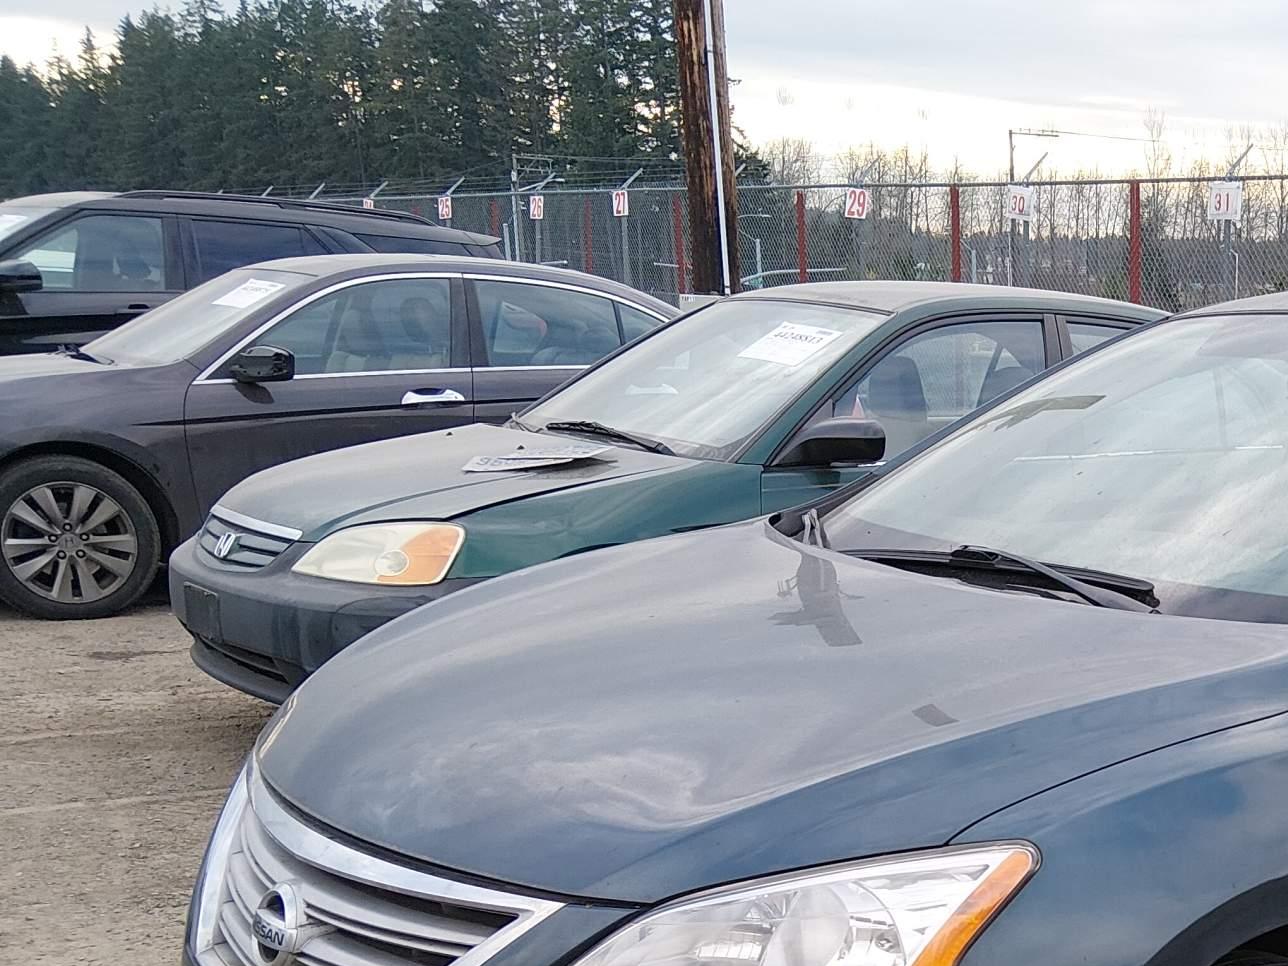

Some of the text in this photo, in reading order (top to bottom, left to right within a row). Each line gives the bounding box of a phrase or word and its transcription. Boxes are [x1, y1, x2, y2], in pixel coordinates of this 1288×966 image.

[439, 198, 450, 218] 25
[531, 197, 543, 218] 26
[615, 191, 626, 215] 27
[847, 190, 866, 217] 29
[1011, 195, 1025, 213] 30
[1214, 192, 1230, 212] 31
